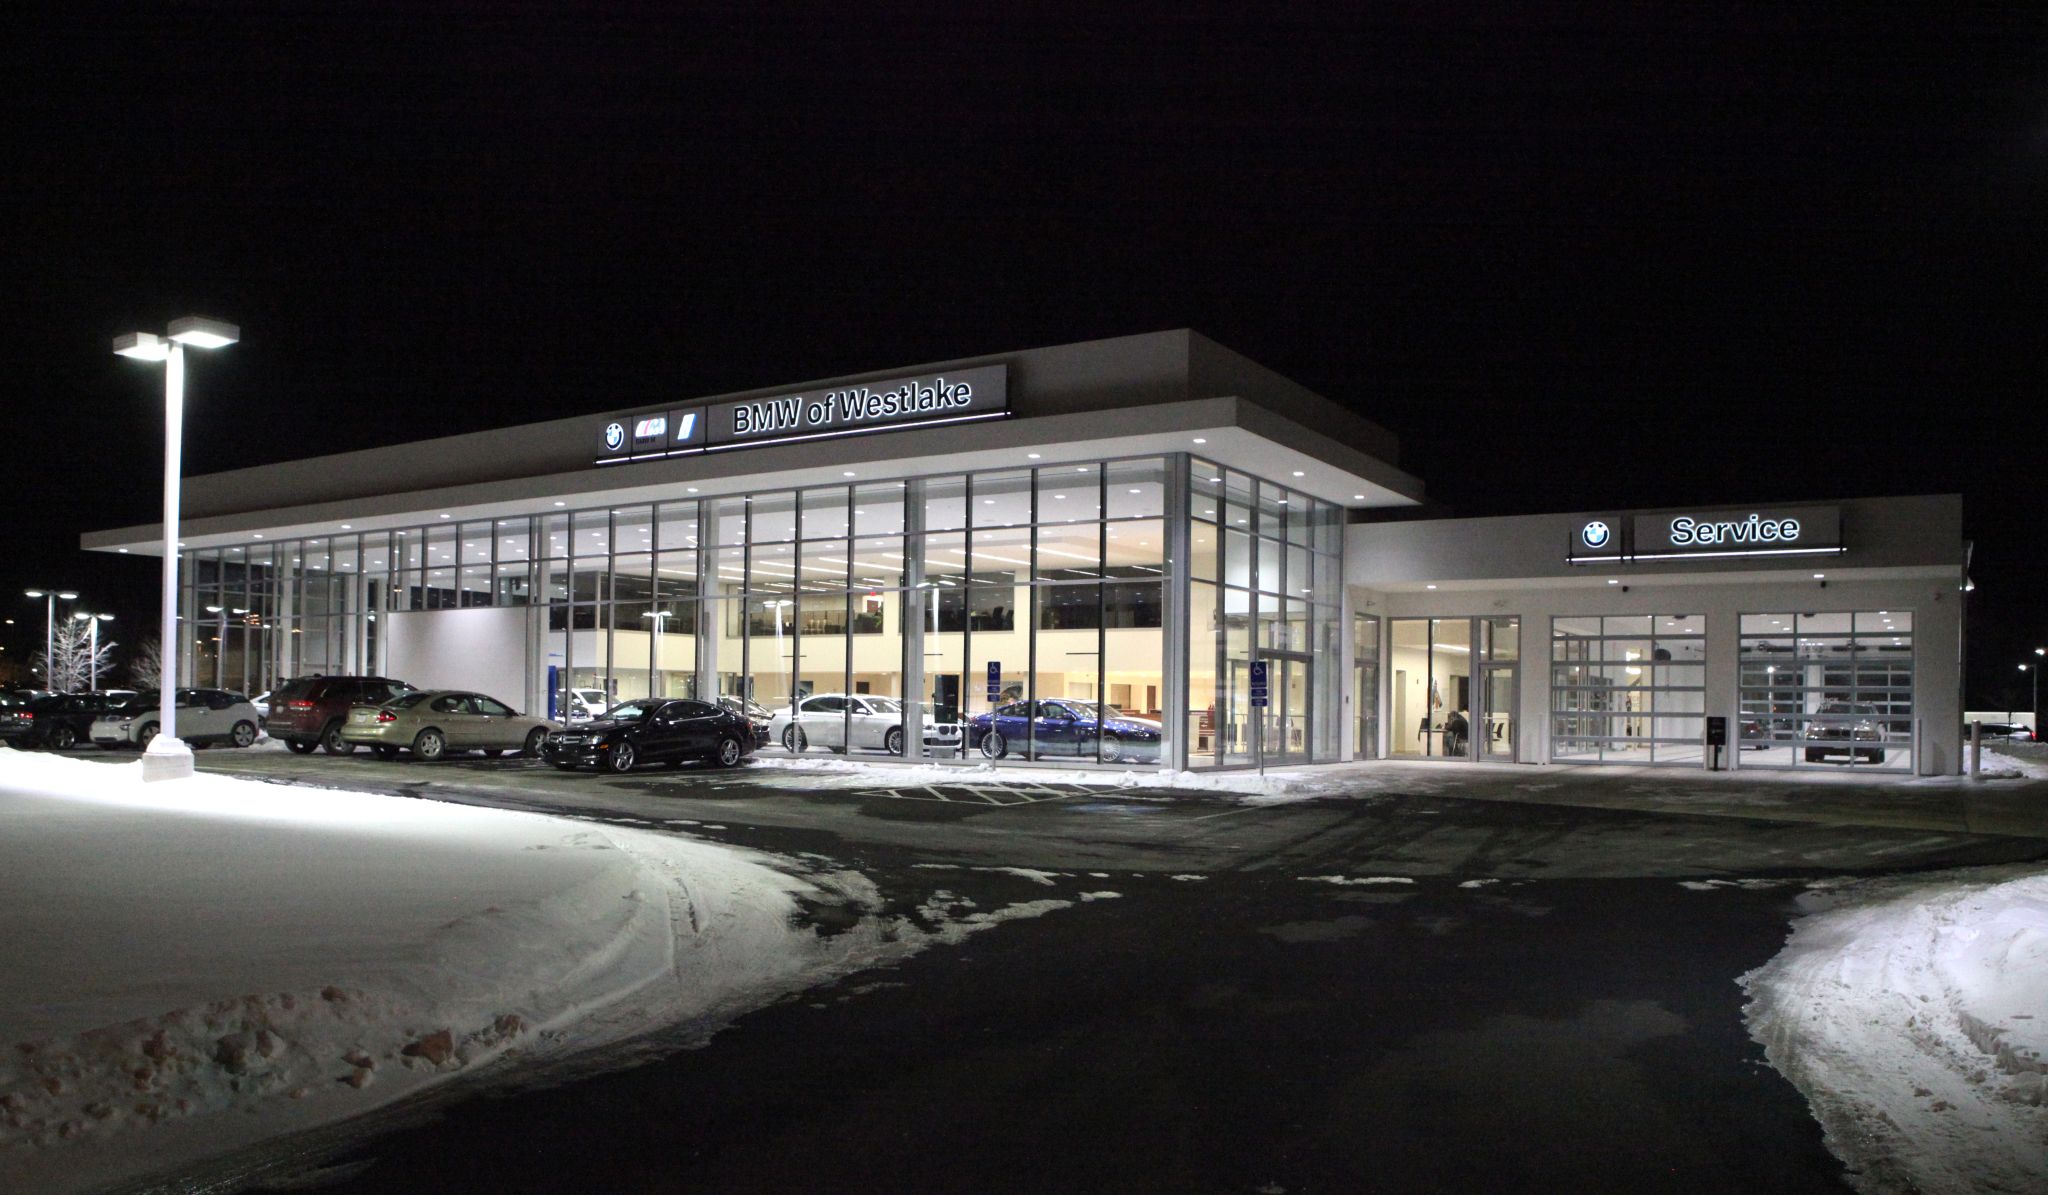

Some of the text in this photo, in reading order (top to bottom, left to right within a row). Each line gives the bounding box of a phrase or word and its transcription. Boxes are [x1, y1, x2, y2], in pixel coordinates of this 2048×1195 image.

[733, 378, 972, 434] BMW of Westlake
[1671, 513, 1800, 545] Service
